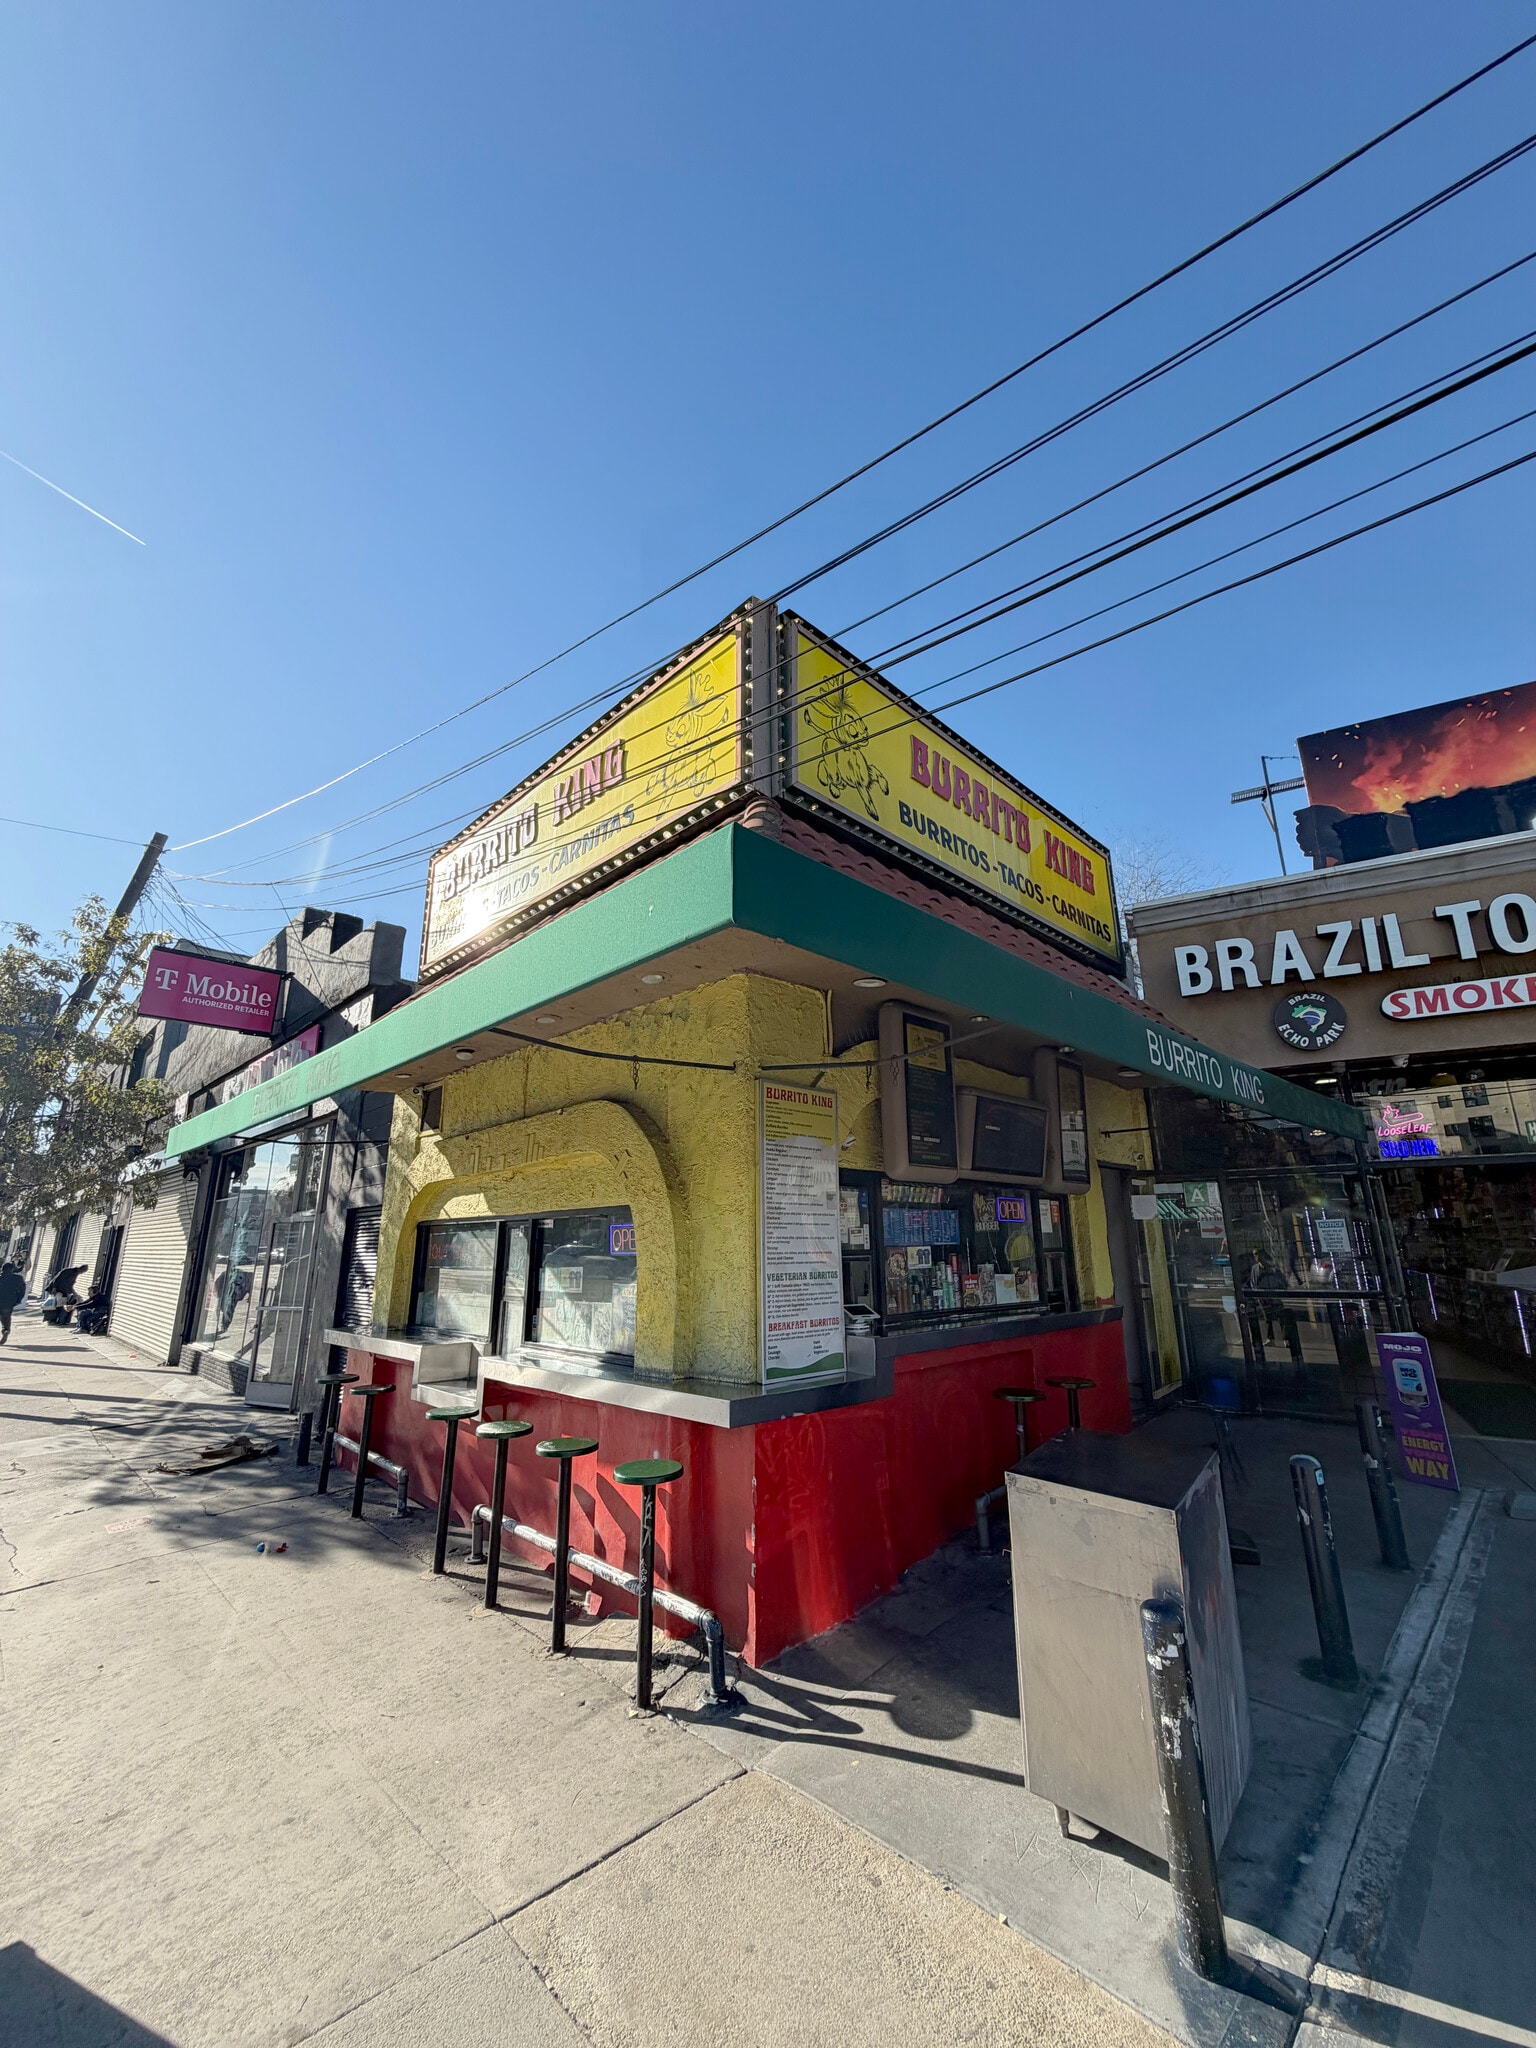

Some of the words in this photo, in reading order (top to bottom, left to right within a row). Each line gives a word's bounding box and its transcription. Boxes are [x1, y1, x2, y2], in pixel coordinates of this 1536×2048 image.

[553, 738, 628, 827] KING
[911, 734, 1031, 854] BURRITO
[1044, 829, 1096, 896] KING
[1174, 912, 1431, 998] BRAZIL
[184, 973, 272, 1008] Mobile
[1288, 993, 1326, 1006] BRAZIL
[182, 996, 234, 1011] AUTHORIZED
[235, 1005, 270, 1017] RETAILER
[1278, 1023, 1310, 1047] ECHO
[1315, 1022, 1345, 1047] PARK
[1146, 1028, 1223, 1089] BURRITO
[1230, 1066, 1265, 1105] KING
[766, 1087, 809, 1104] BURRITO
[811, 1094, 833, 1108] KING
[1379, 1139, 1410, 1158] SOLD
[1410, 1138, 1440, 1156] HERE
[1190, 1188, 1205, 1202] A
[1000, 1201, 1023, 1219] OPEN
[975, 1220, 999, 1232] BURGER
[612, 1228, 636, 1252] OPE
[809, 1270, 838, 1280] BURRITOS
[768, 1319, 808, 1332] BREAKFAST
[809, 1317, 840, 1328] BURRITOS
[1382, 1343, 1422, 1352] MOJO
[1401, 1435, 1445, 1453] ENERGY
[1405, 1455, 1450, 1481] WAY
